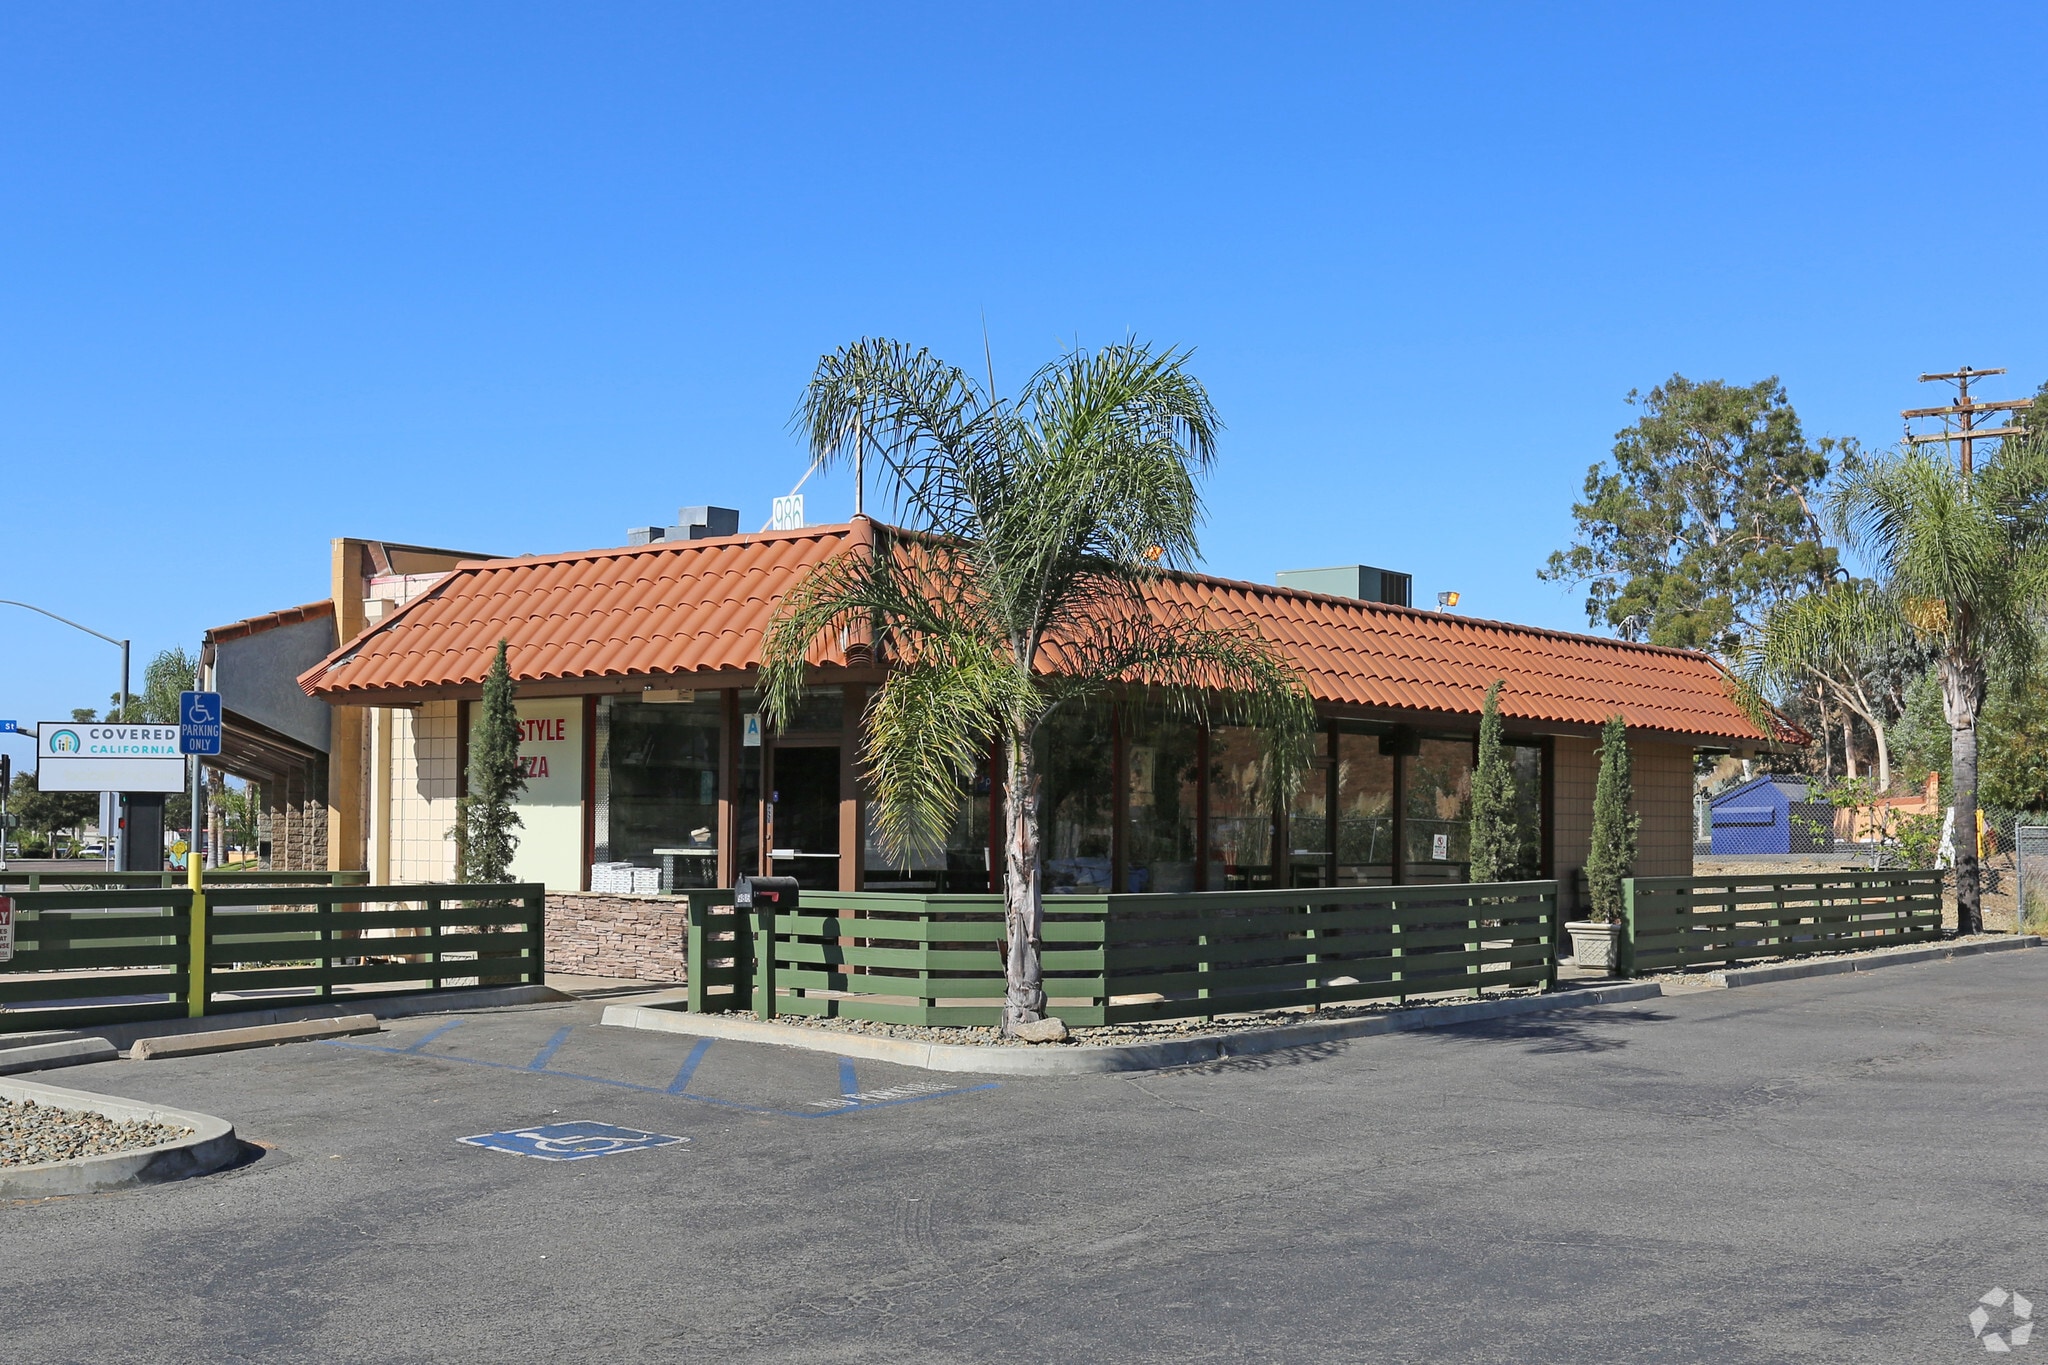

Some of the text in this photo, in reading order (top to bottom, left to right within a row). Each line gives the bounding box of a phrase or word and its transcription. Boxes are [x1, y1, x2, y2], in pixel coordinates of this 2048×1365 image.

[774, 497, 802, 530] 986
[5, 722, 15, 730] St
[182, 724, 219, 737] PARKING
[516, 718, 566, 741] STYLE
[748, 718, 758, 733] A
[90, 728, 176, 740] COVERED
[90, 745, 176, 754] CALIFORNIA
[189, 738, 211, 751] ONLY
